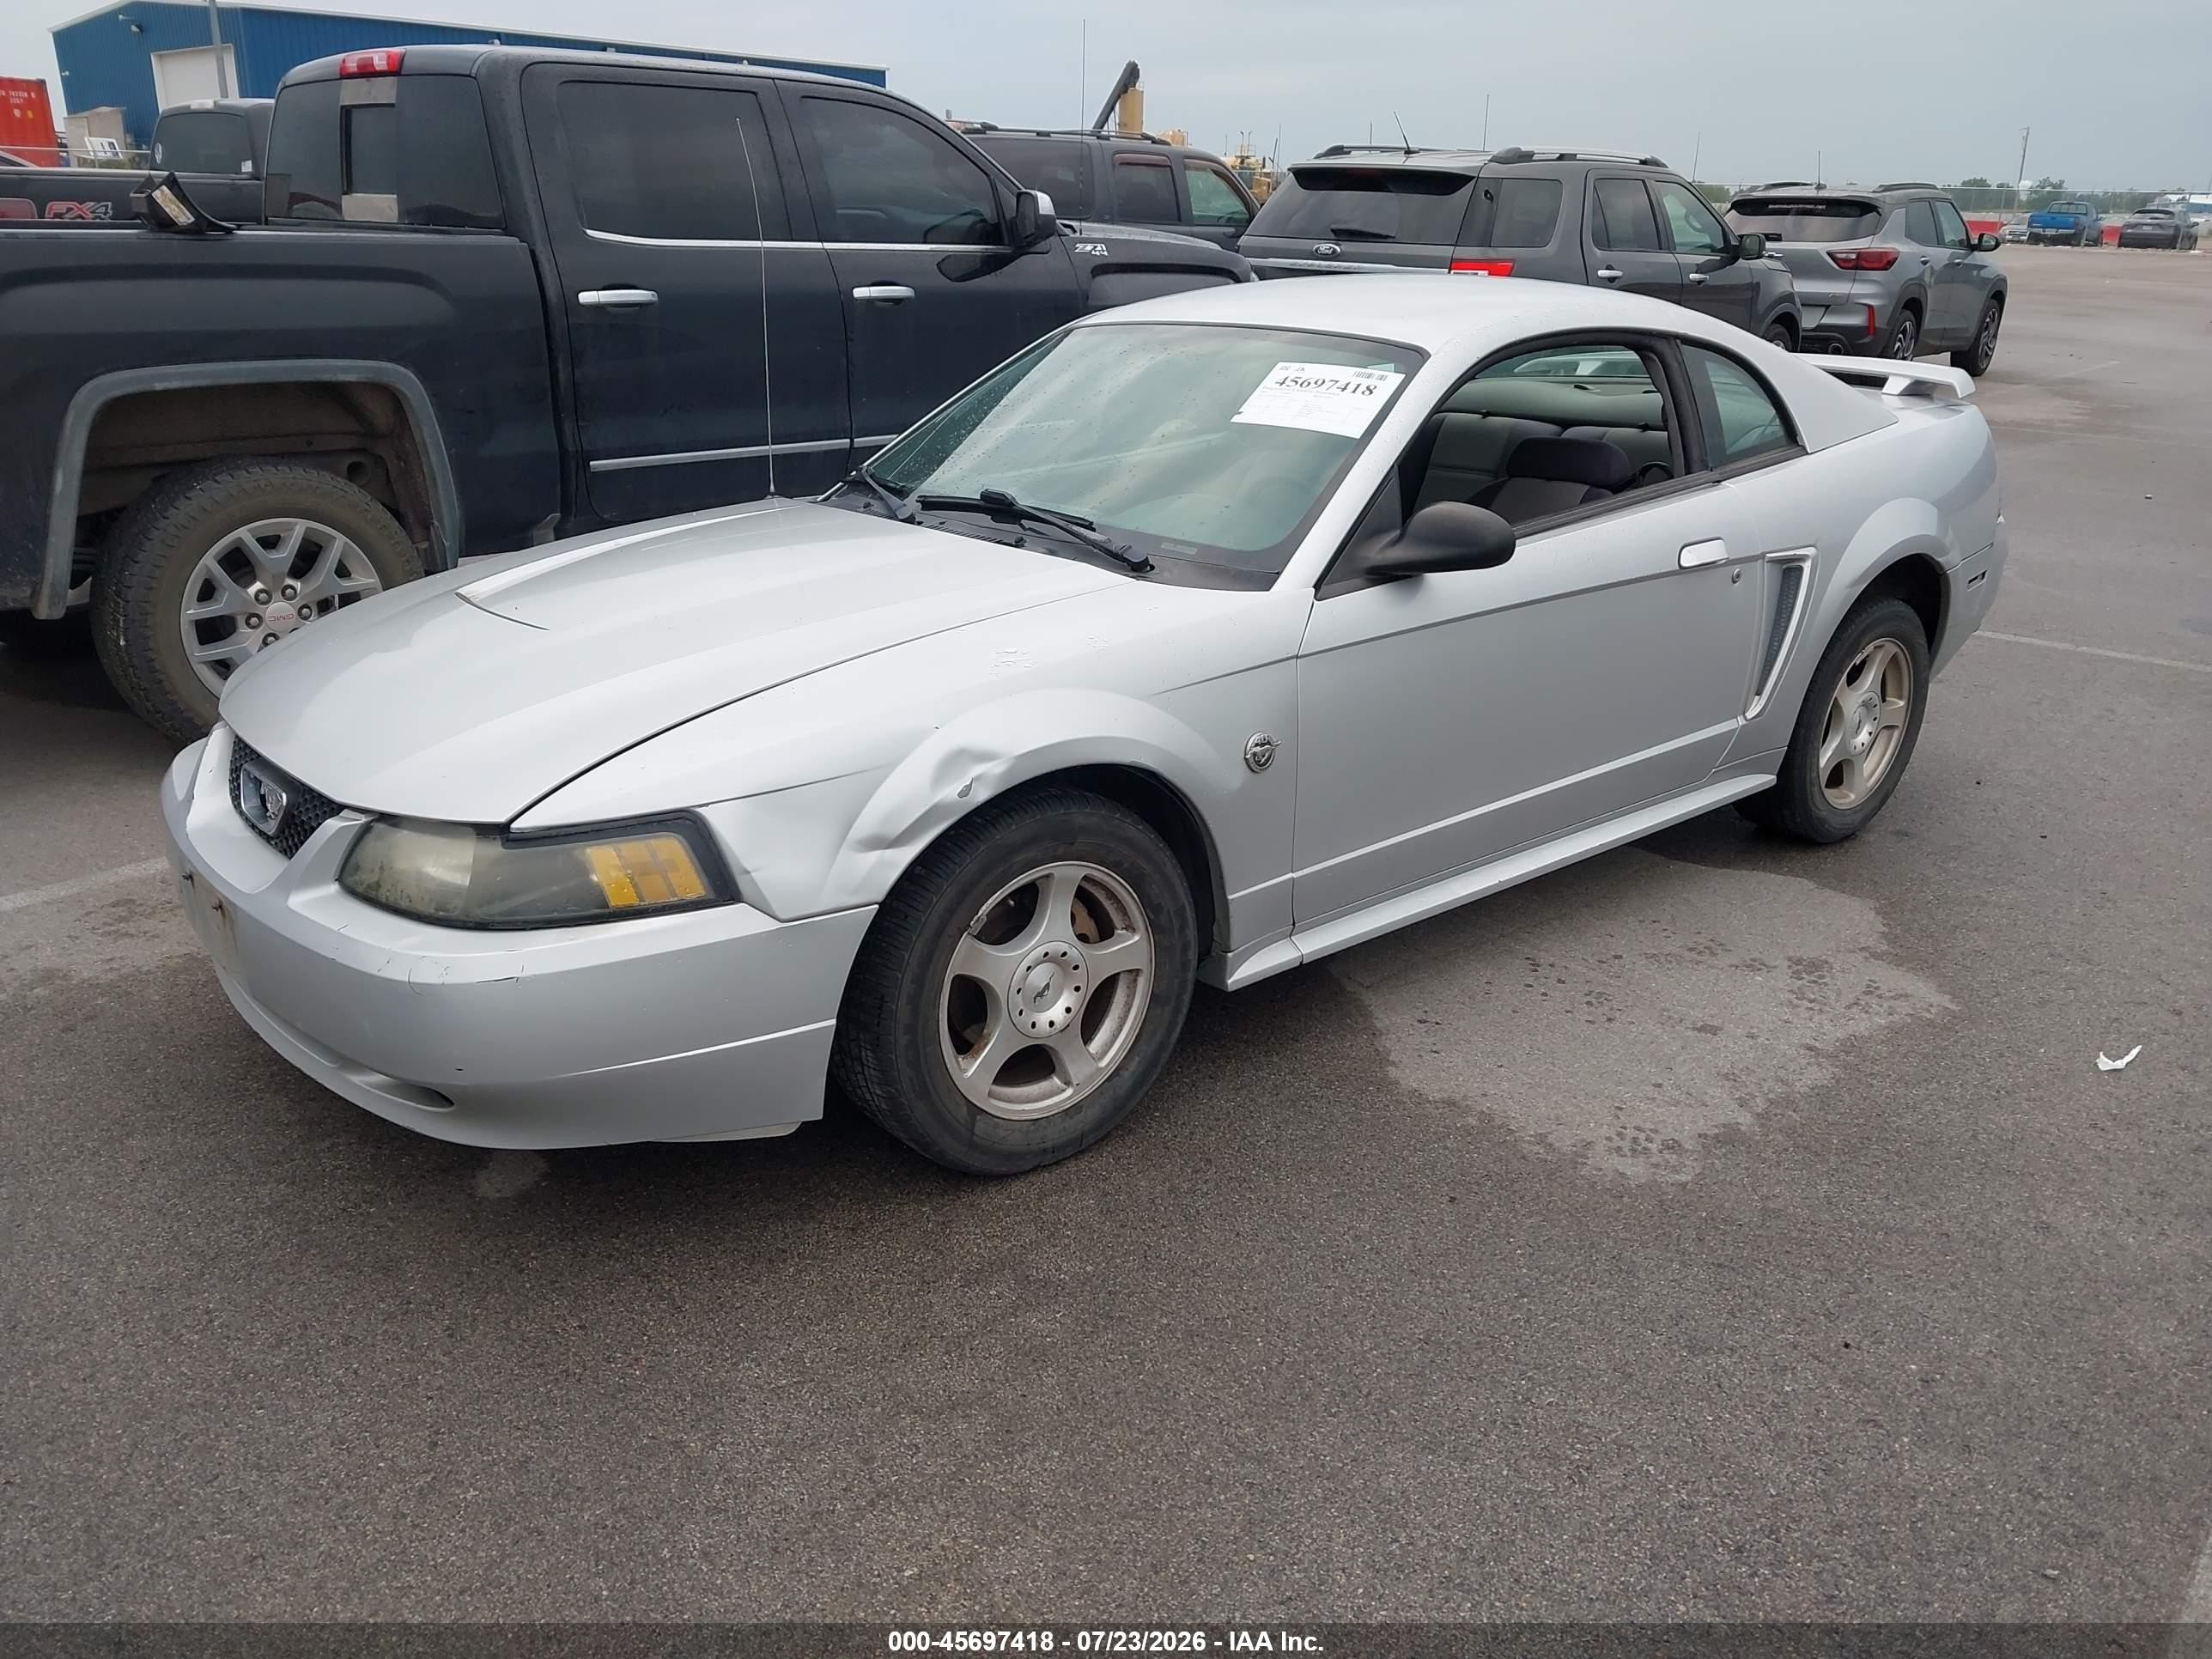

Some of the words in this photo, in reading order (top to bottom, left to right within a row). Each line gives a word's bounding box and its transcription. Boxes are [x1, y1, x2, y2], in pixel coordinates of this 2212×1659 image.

[46, 202, 112, 220] FX4
[1074, 243, 1107, 252] Z71
[1317, 246, 1334, 254] Ford
[1274, 375, 1377, 397] 45697418
[267, 613, 295, 622] GMC
